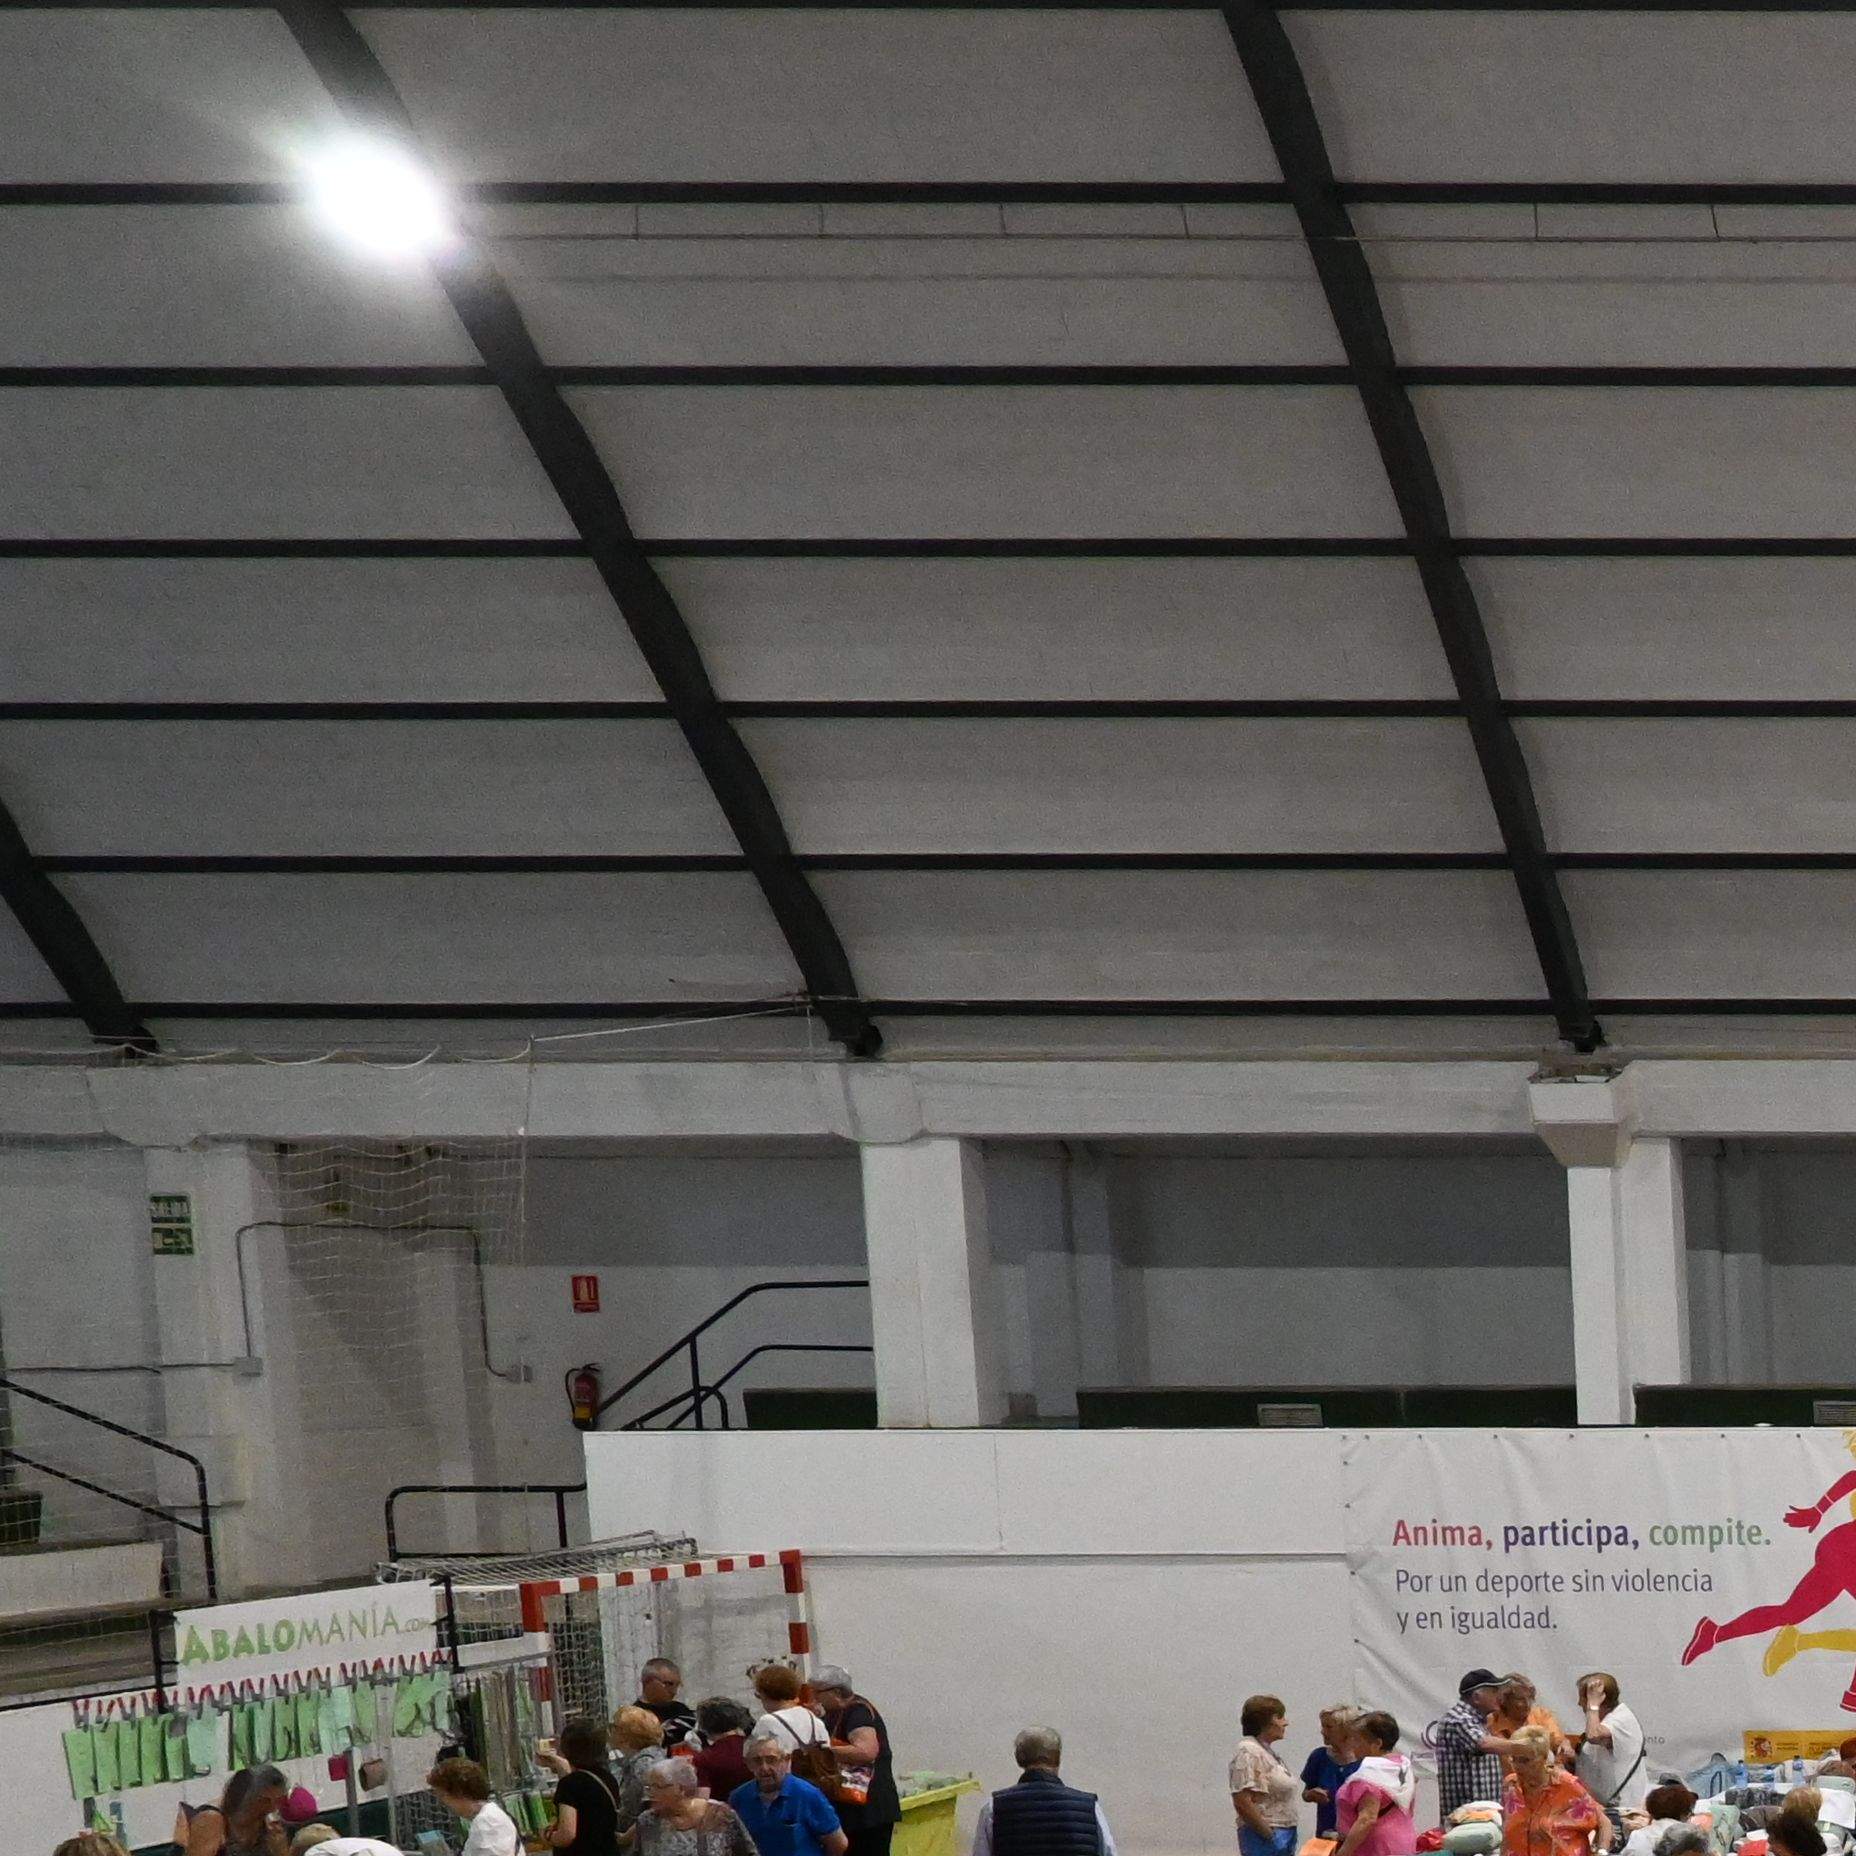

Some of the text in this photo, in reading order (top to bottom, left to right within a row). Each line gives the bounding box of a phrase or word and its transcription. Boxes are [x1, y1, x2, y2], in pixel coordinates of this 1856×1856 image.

[1392, 1518, 1771, 1554] Anima, participa, compite.
[1396, 1567, 1713, 1600] Por un deporte sin violencia
[1396, 1605, 1557, 1636] y en igualdad.
